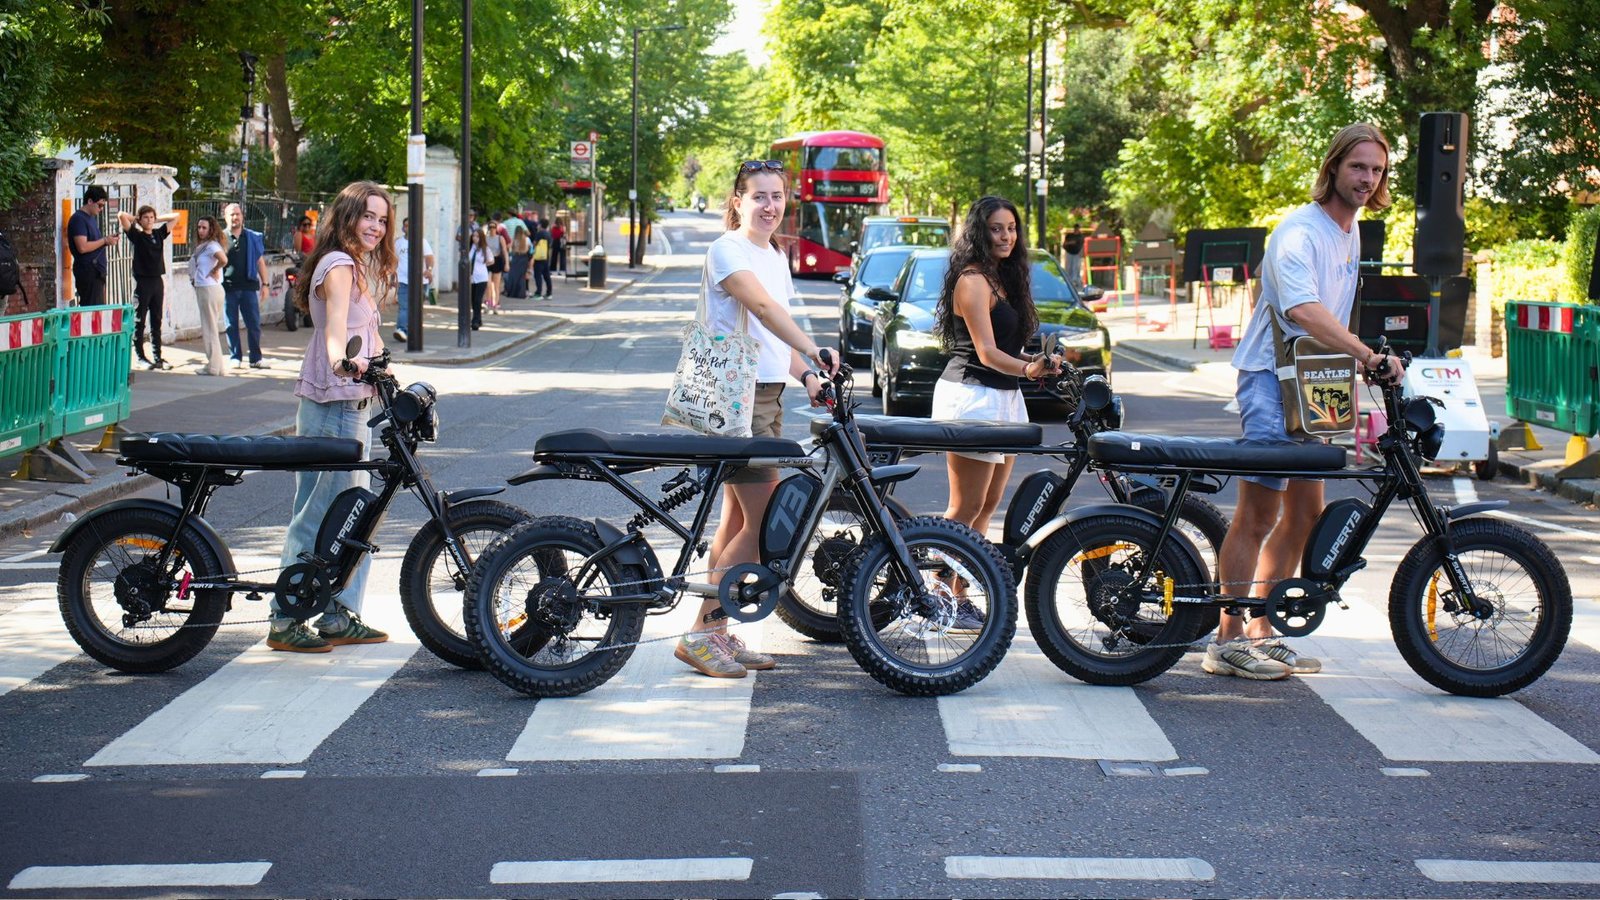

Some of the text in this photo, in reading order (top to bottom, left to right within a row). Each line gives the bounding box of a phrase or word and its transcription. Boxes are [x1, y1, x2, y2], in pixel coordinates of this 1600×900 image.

[860, 184, 875, 194] 189
[1386, 317, 1408, 325] CTM
[710, 356, 731, 369] Port
[1303, 369, 1351, 379] BEATLES
[1421, 368, 1462, 379] CTM
[770, 483, 808, 535] 73
[1020, 481, 1054, 536] SUPER73
[1321, 509, 1361, 570] SUPER73
[1452, 561, 1472, 594] SUPER73
